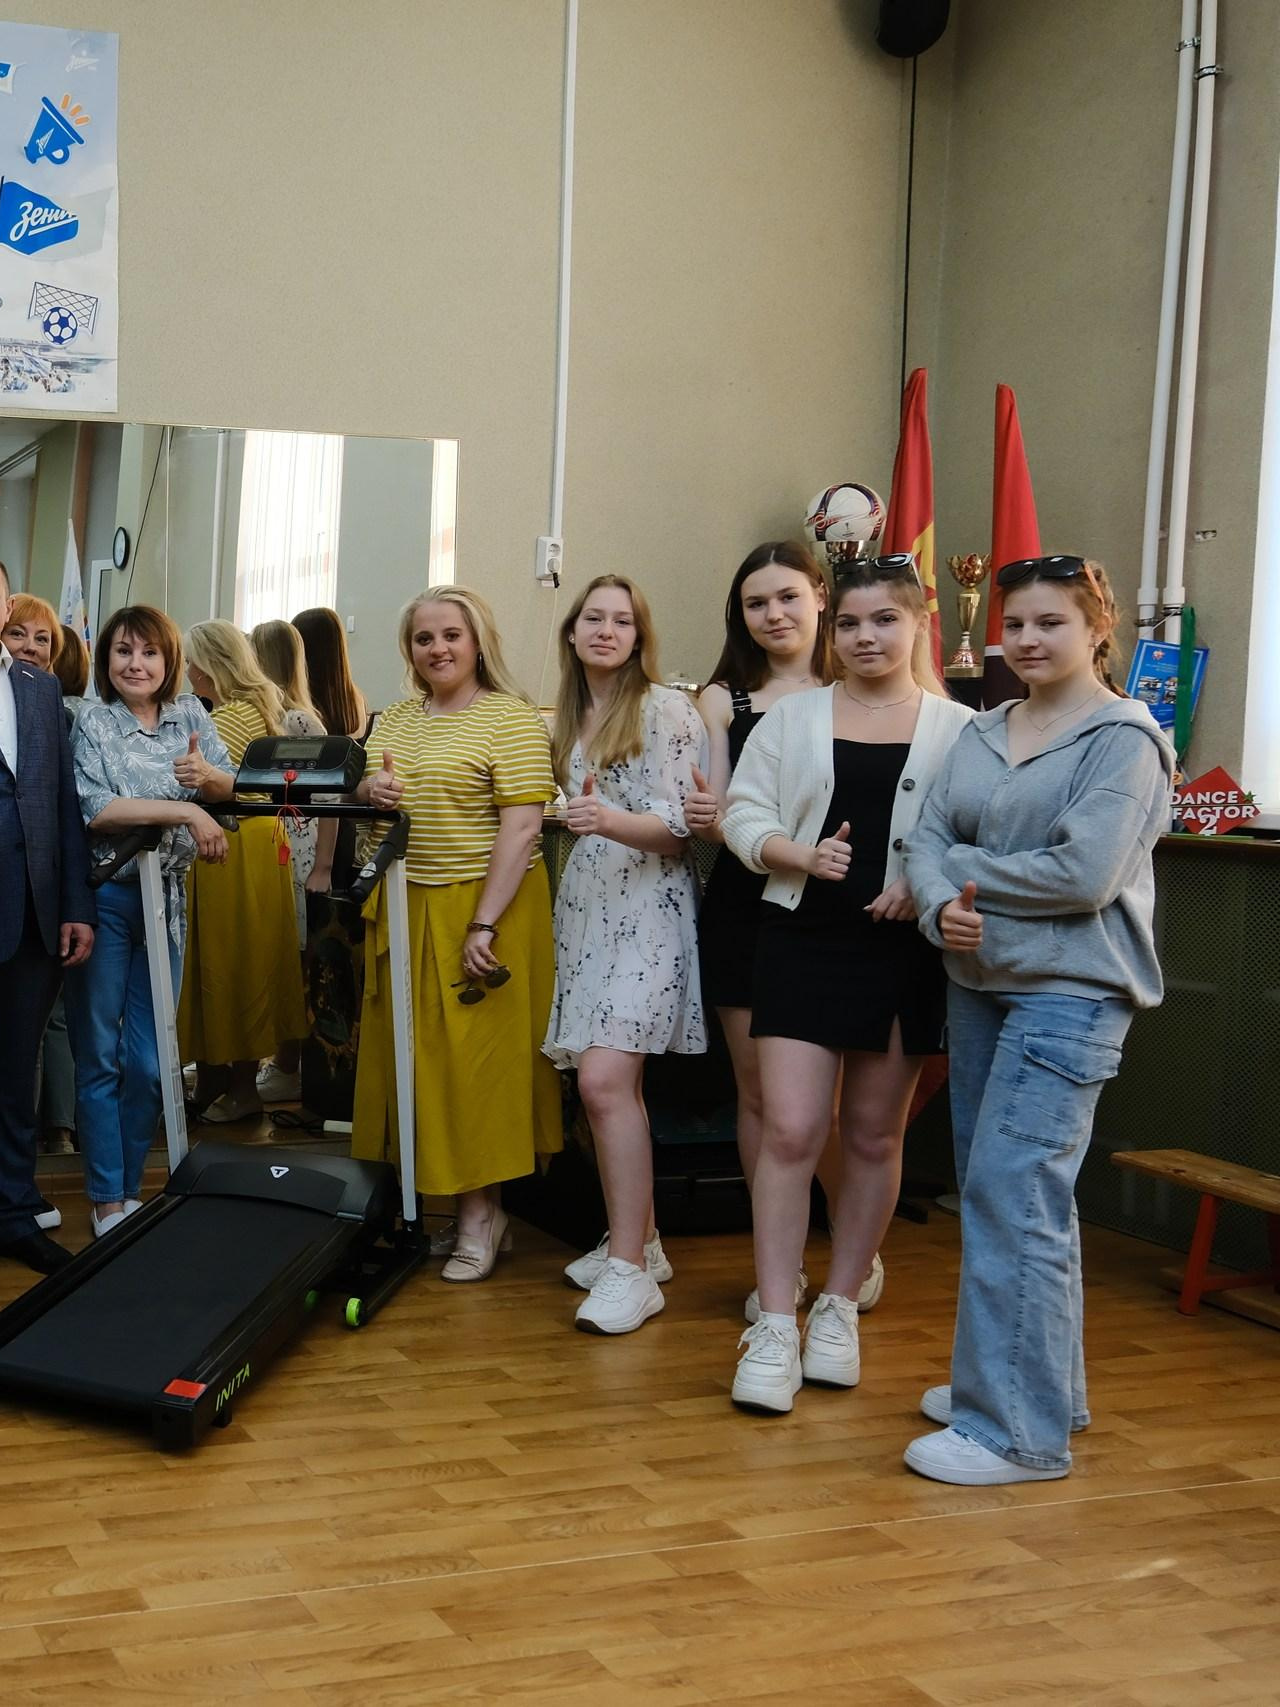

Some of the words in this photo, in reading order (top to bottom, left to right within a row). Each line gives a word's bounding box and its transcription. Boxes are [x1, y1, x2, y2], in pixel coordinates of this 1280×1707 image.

[1171, 790, 1239, 805] DANCE
[1173, 805, 1256, 820] FACTOR
[1199, 814, 1218, 836] 2
[215, 1362, 251, 1412] INITA
